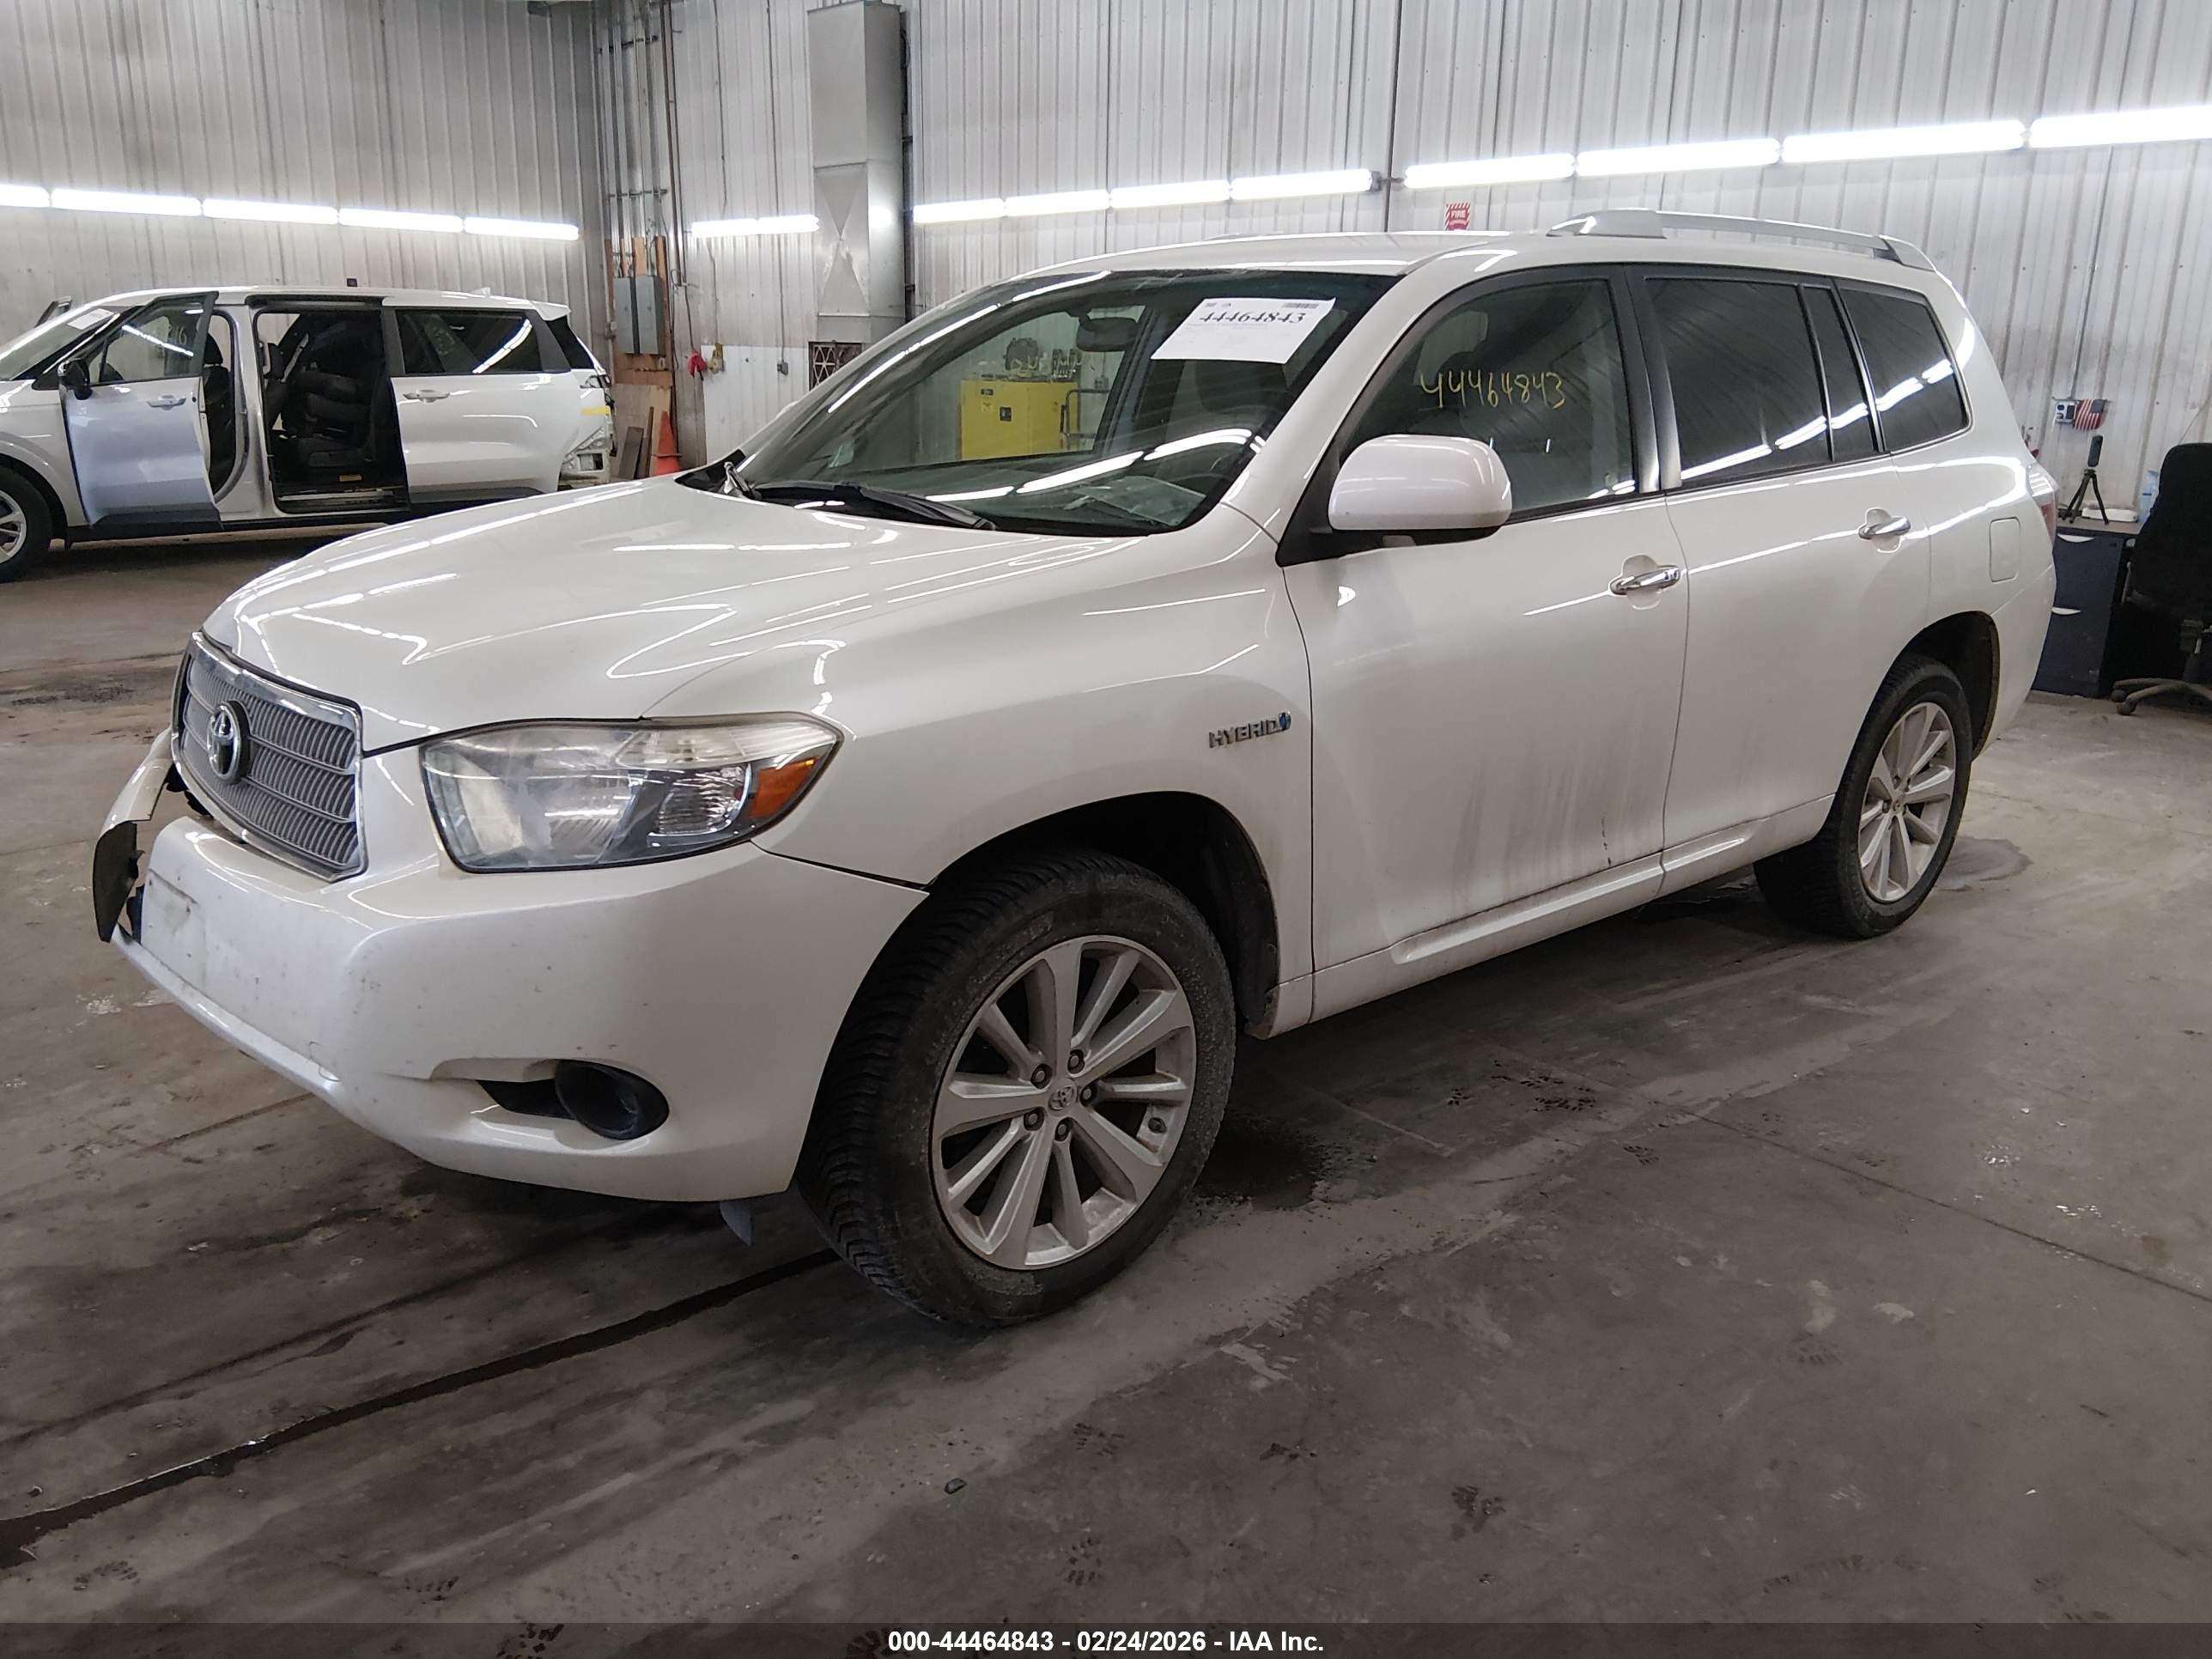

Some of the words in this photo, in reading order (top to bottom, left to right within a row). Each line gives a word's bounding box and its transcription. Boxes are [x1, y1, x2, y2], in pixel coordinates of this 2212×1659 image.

[1450, 210, 1466, 219] FIRE
[1199, 311, 1306, 324] 44464843
[1420, 369, 1565, 410] 44464843
[1208, 719, 1278, 749] HYBRID
